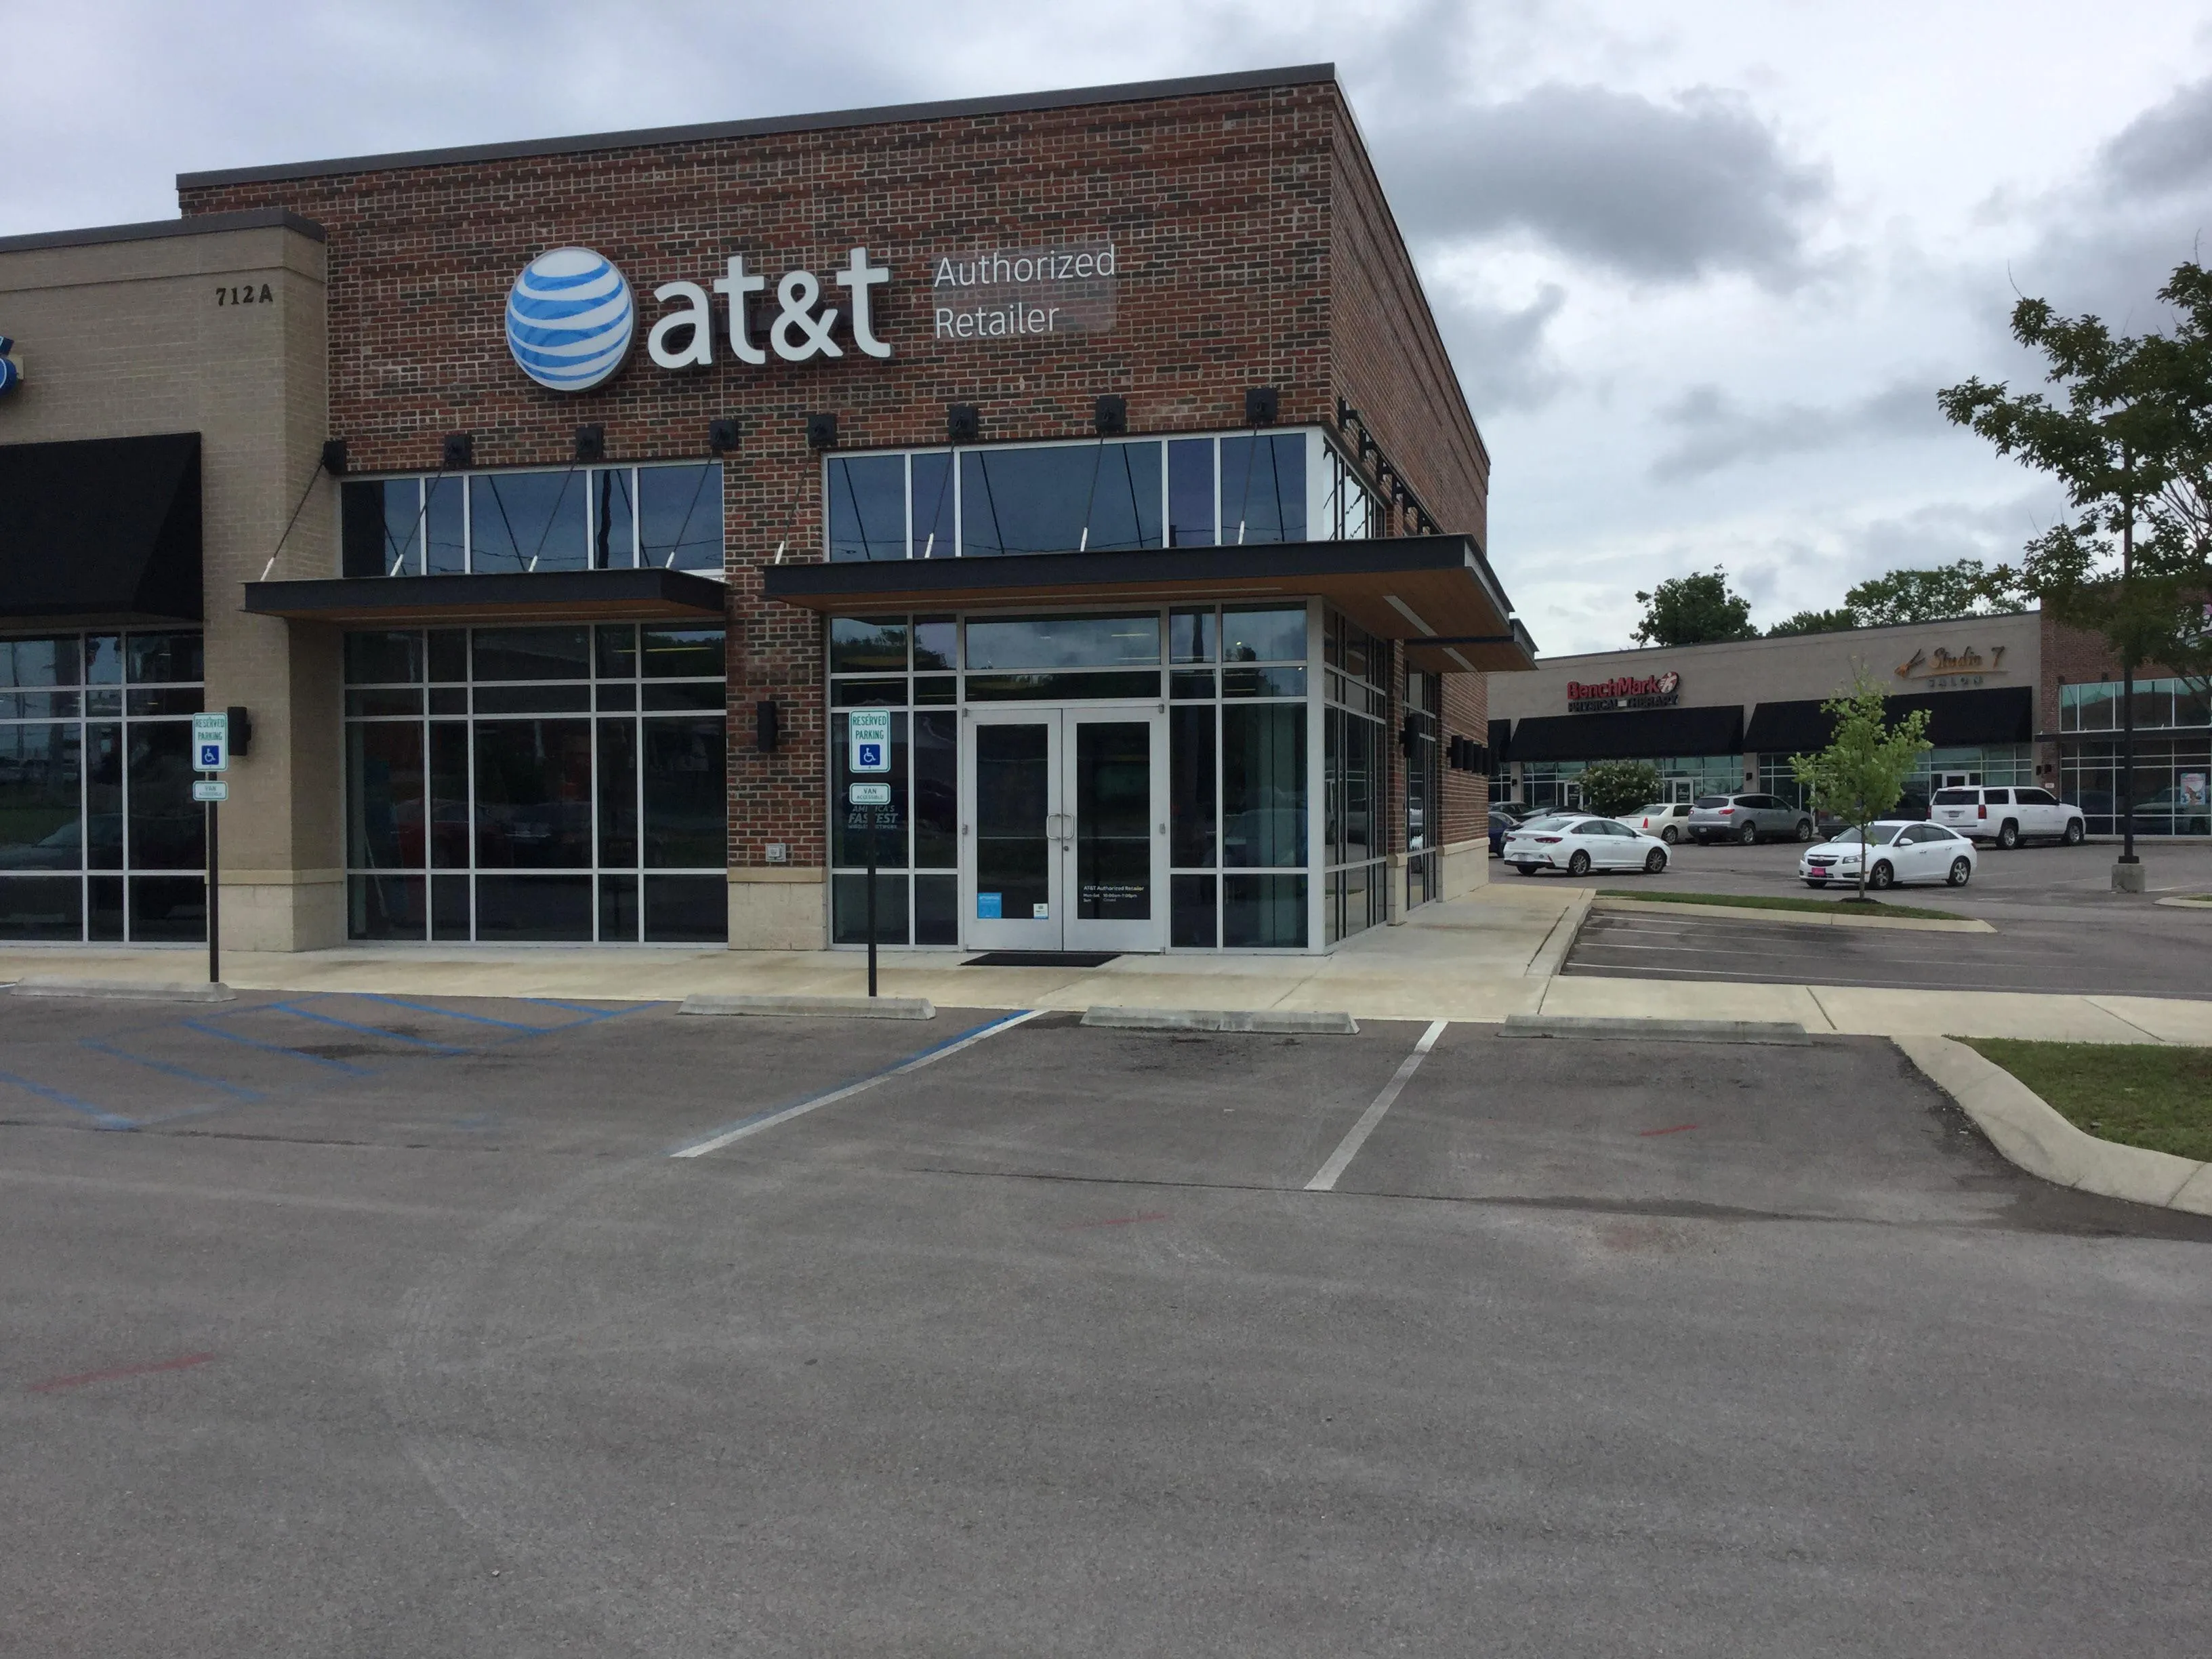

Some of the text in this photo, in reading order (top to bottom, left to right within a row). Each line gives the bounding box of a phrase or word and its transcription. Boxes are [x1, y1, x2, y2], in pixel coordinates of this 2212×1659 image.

[934, 244, 1115, 287] Authorized
[216, 285, 273, 306] 712A
[648, 247, 893, 369] at&t
[936, 302, 1059, 339] Retailer
[1567, 675, 1661, 699] BenchMark
[1568, 699, 1618, 712] PHYSICAL
[195, 719, 224, 727] RESERVED
[853, 716, 886, 726] RESERVED
[198, 732, 223, 741] PARKING
[855, 730, 884, 740] PARKING
[848, 813, 899, 824] FASEST
